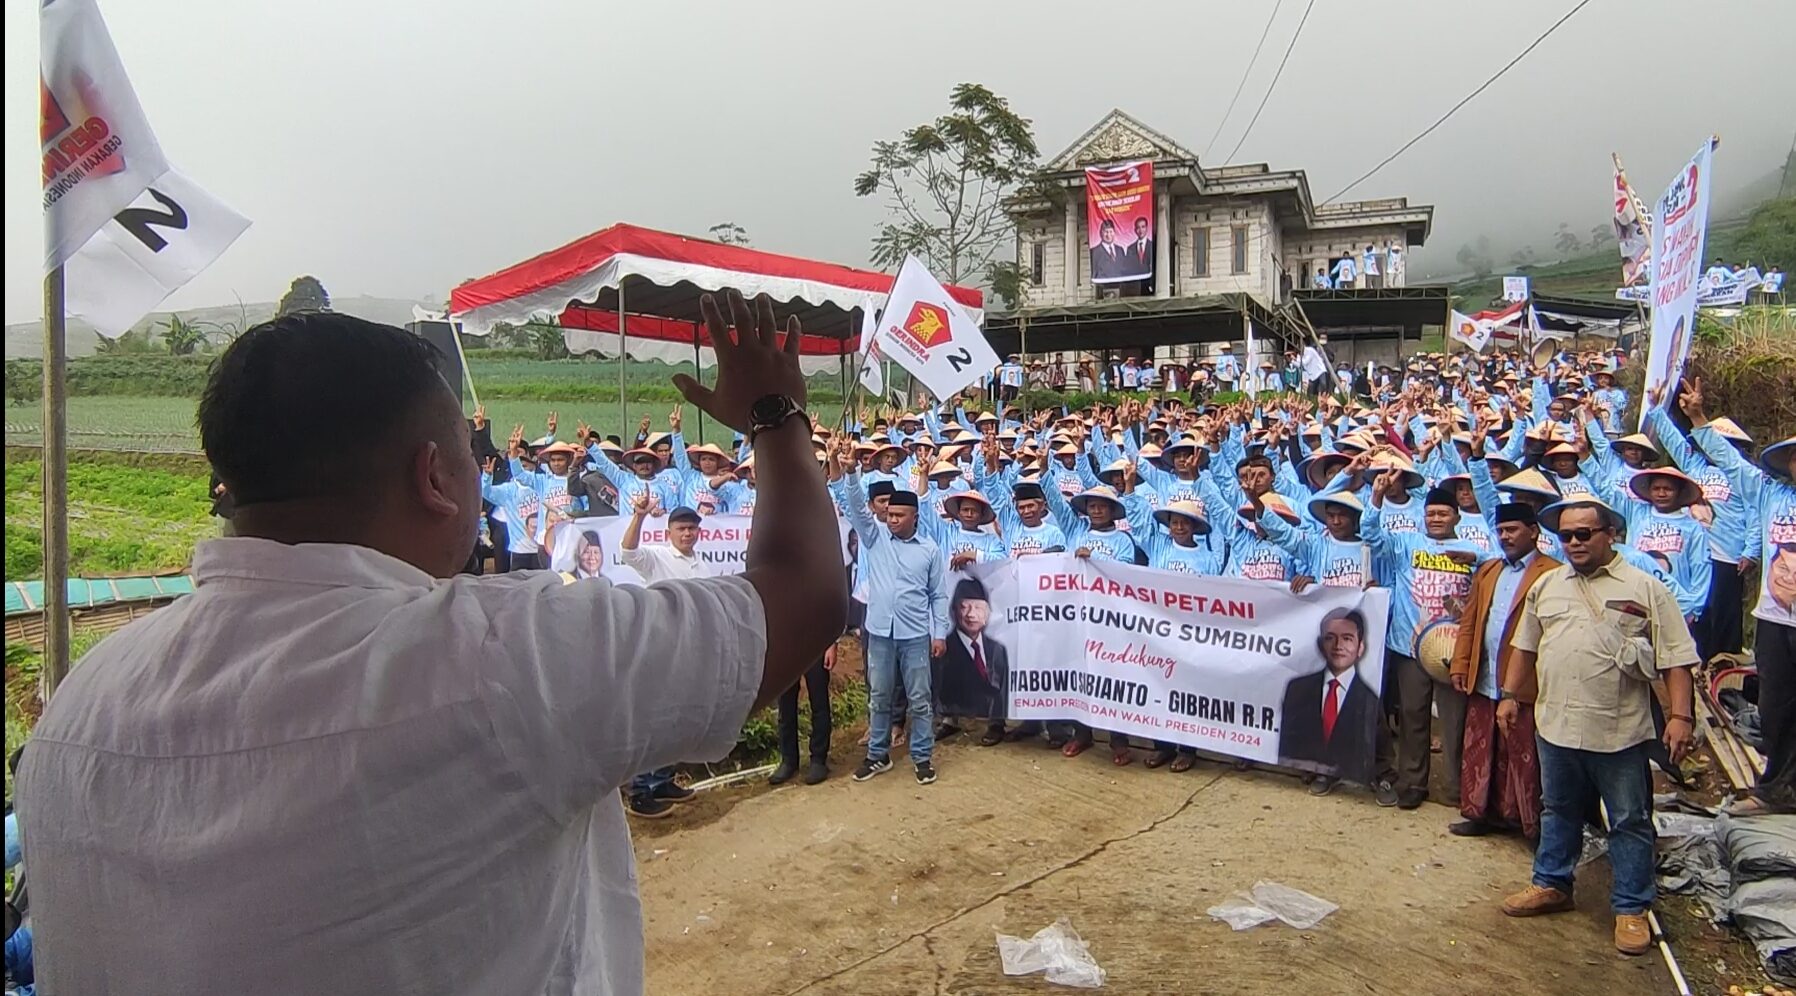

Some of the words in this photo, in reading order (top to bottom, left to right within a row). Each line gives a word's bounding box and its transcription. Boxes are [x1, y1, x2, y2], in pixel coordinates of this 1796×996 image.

[1128, 168, 1140, 183] 2
[113, 187, 188, 253] 2
[890, 325, 930, 362] GERINDRA
[1476, 331, 1484, 341] 2
[946, 347, 972, 373] 2
[1039, 573, 1157, 604] DEKLARASI
[1164, 591, 1254, 619] PETANI
[1007, 604, 1076, 624] LERENG
[1080, 607, 1171, 637] GUNUNG
[1178, 624, 1292, 657] SUMBING
[1084, 638, 1177, 679] Mendukung
[1091, 705, 1117, 718] DAN
[1121, 710, 1160, 727] WAKIL
[1165, 720, 1227, 739] PRESIDEN
[1230, 732, 1261, 746] 2024
[1168, 690, 1235, 724] GIBRAN
[1242, 704, 1279, 732] R.R.
